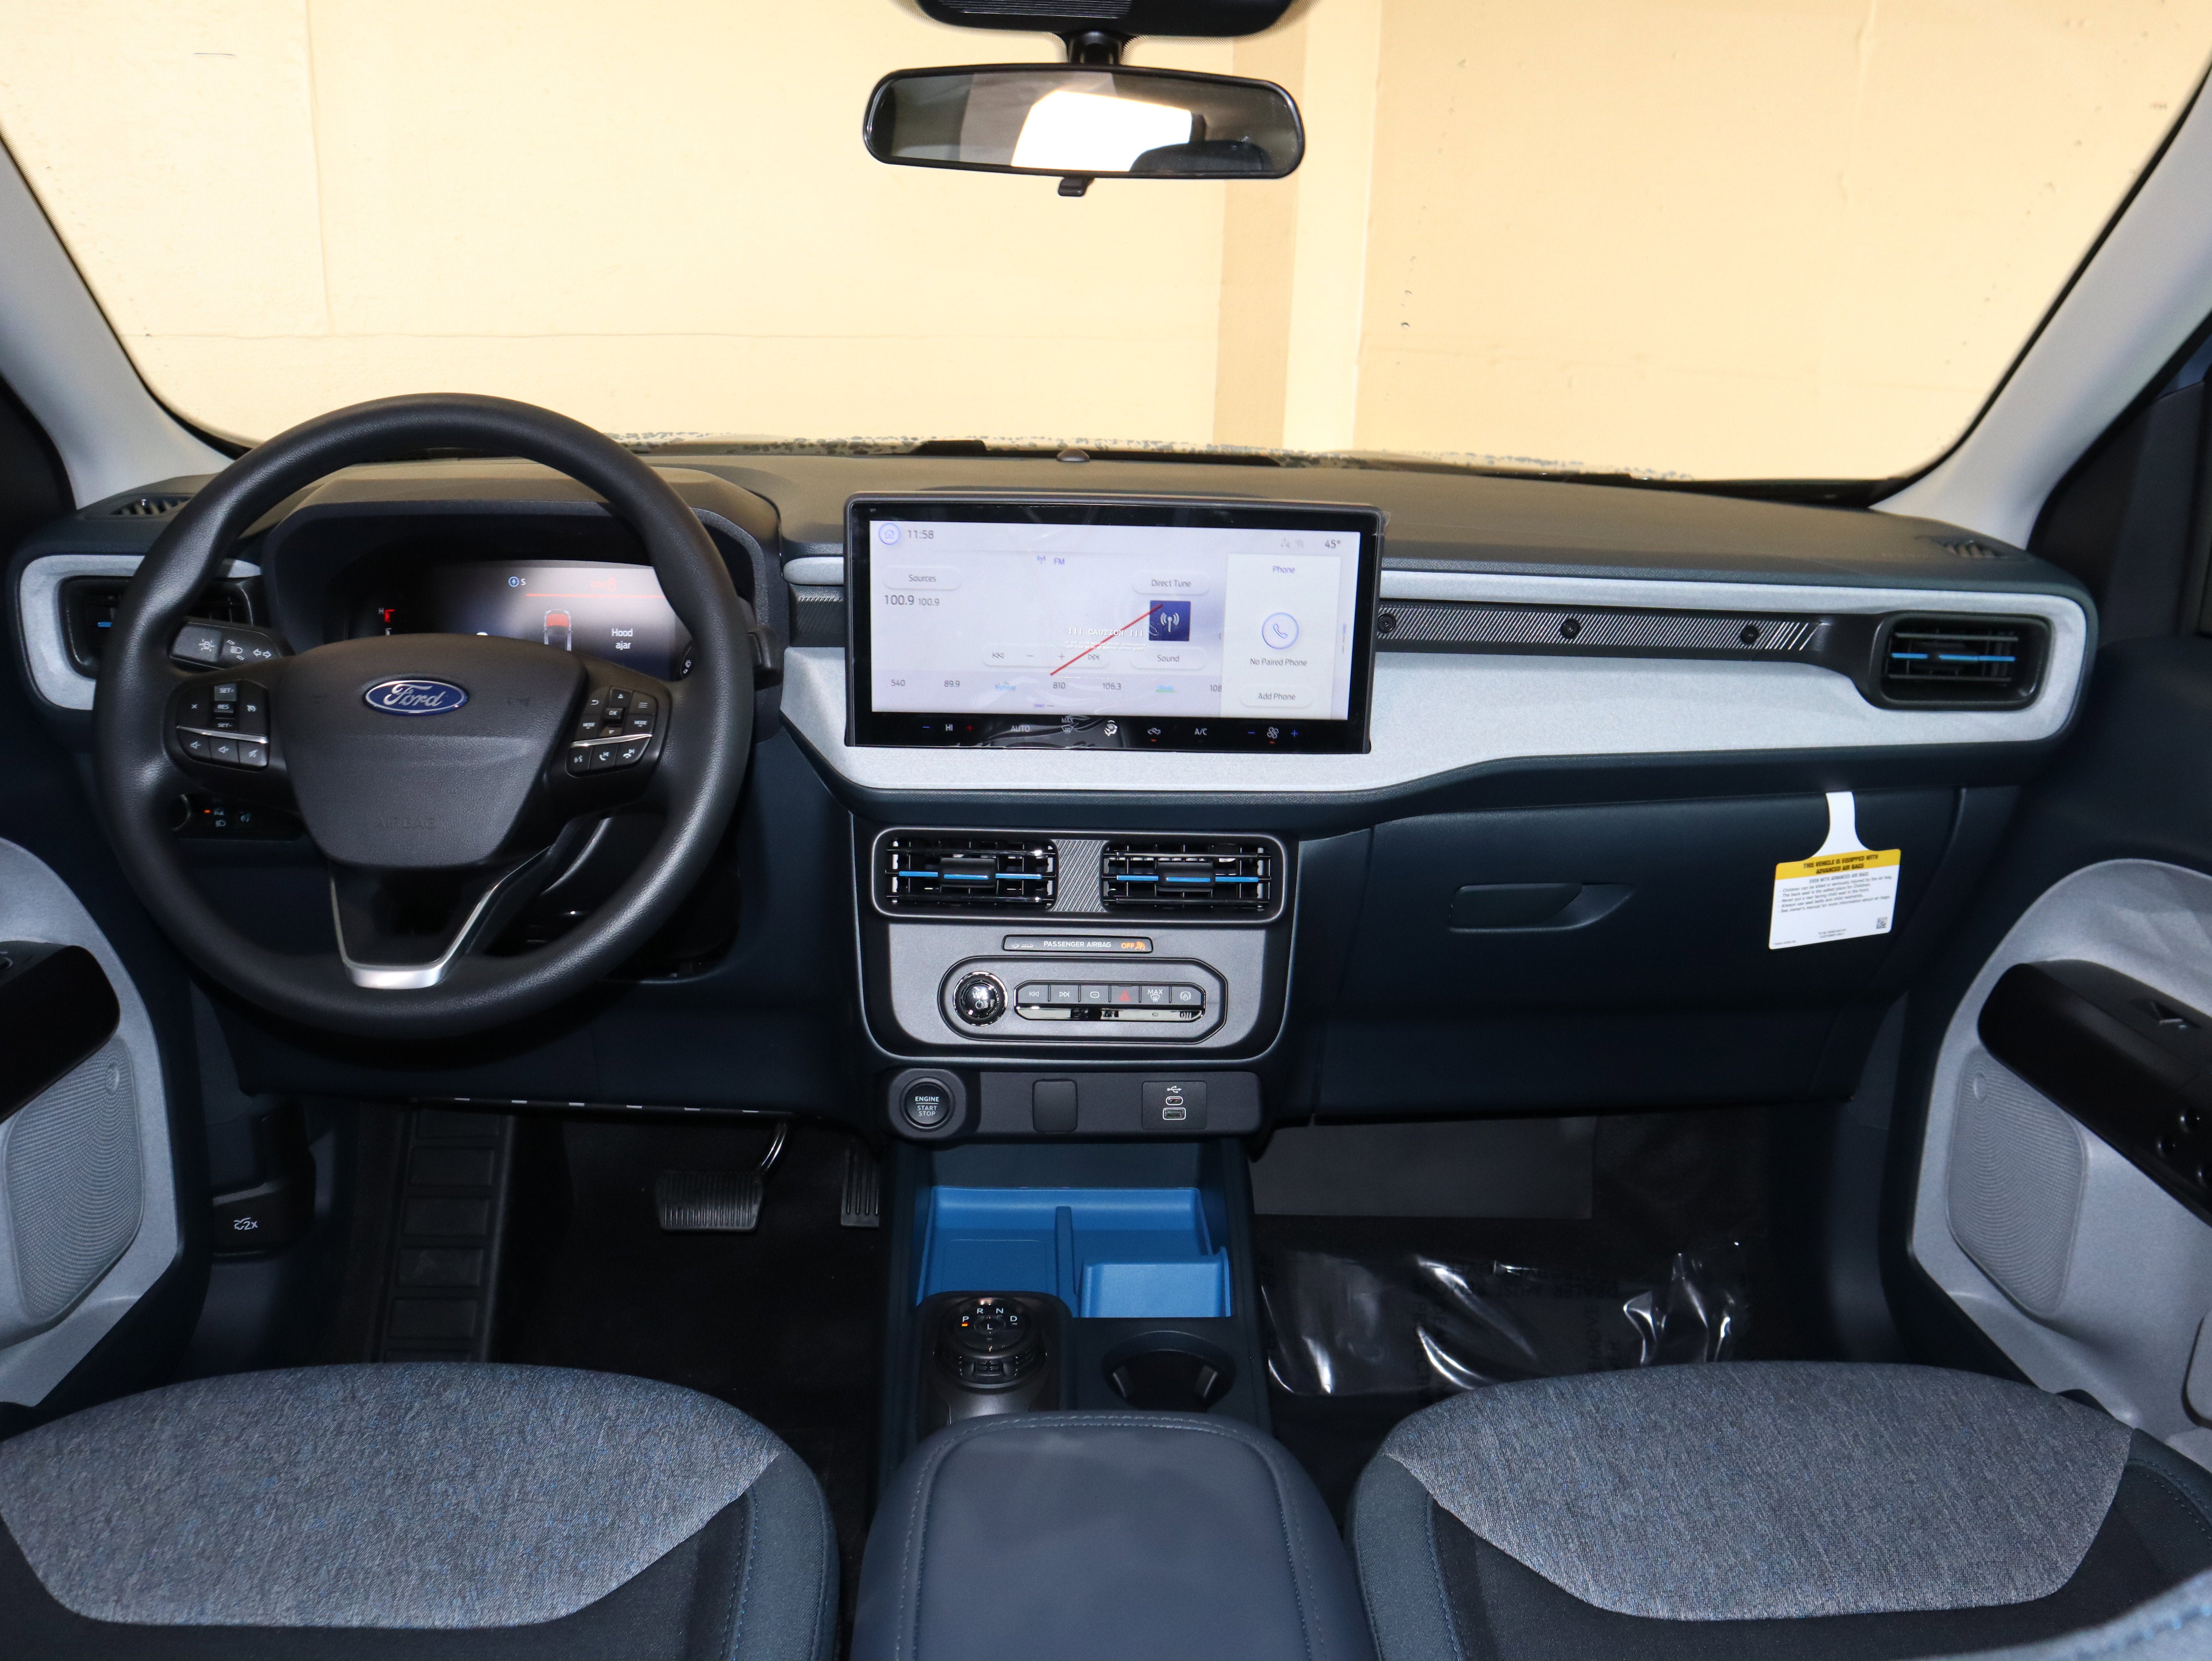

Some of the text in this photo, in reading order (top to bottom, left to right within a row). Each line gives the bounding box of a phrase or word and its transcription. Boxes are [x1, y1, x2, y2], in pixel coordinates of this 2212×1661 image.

[907, 530, 934, 539] 11:58
[1324, 539, 1341, 549] 45°
[1272, 565, 1295, 574] Phone
[884, 595, 914, 605] 100.9
[611, 628, 633, 637] Hood
[615, 641, 631, 650] ajar
[1157, 654, 1180, 663] Sound
[1103, 682, 1121, 691] 106.3
[383, 684, 446, 706] Ford
[1194, 728, 1207, 736] A/C
